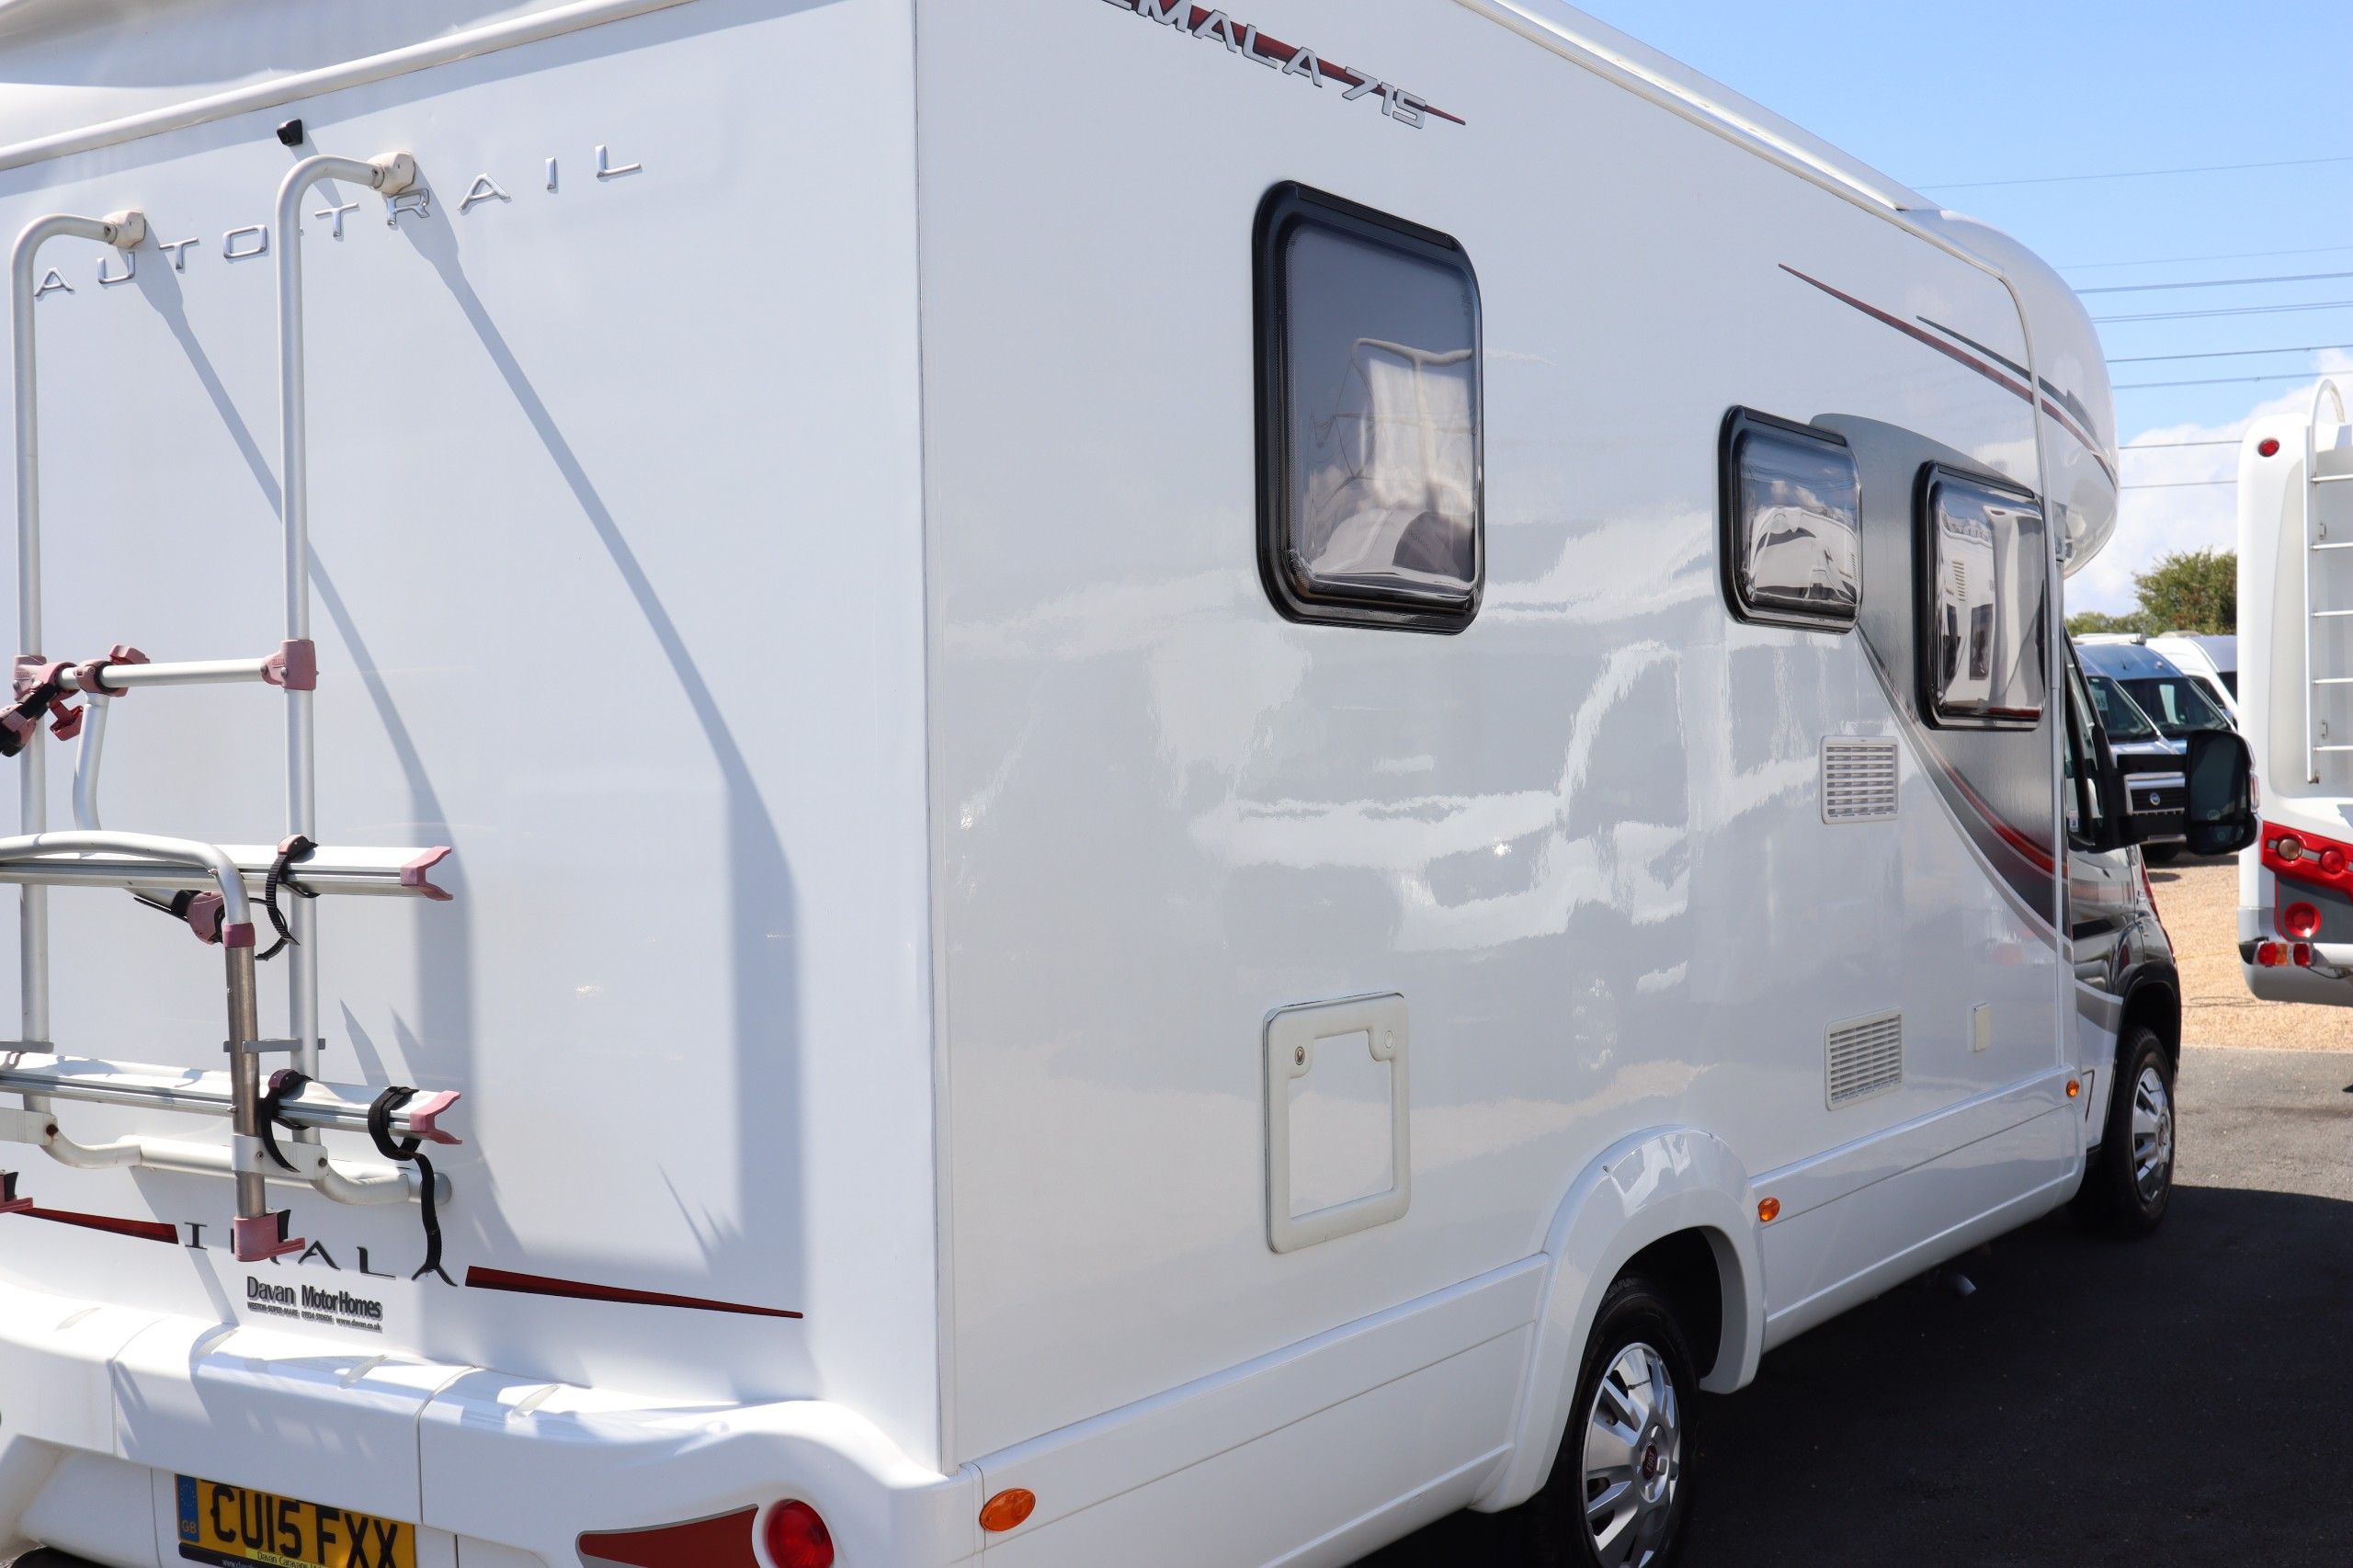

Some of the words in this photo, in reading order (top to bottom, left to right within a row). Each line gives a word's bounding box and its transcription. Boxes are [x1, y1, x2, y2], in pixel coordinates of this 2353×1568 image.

[1100, 0, 1324, 88] MALA
[1342, 66, 1427, 129] 715
[246, 1276, 295, 1304] Davan
[335, 1317, 381, 1331] www.davan.co.uk
[181, 1519, 197, 1534] GB
[210, 1483, 302, 1559] CU15
[315, 1505, 398, 1568] FXX
[256, 1551, 278, 1564] Davan
